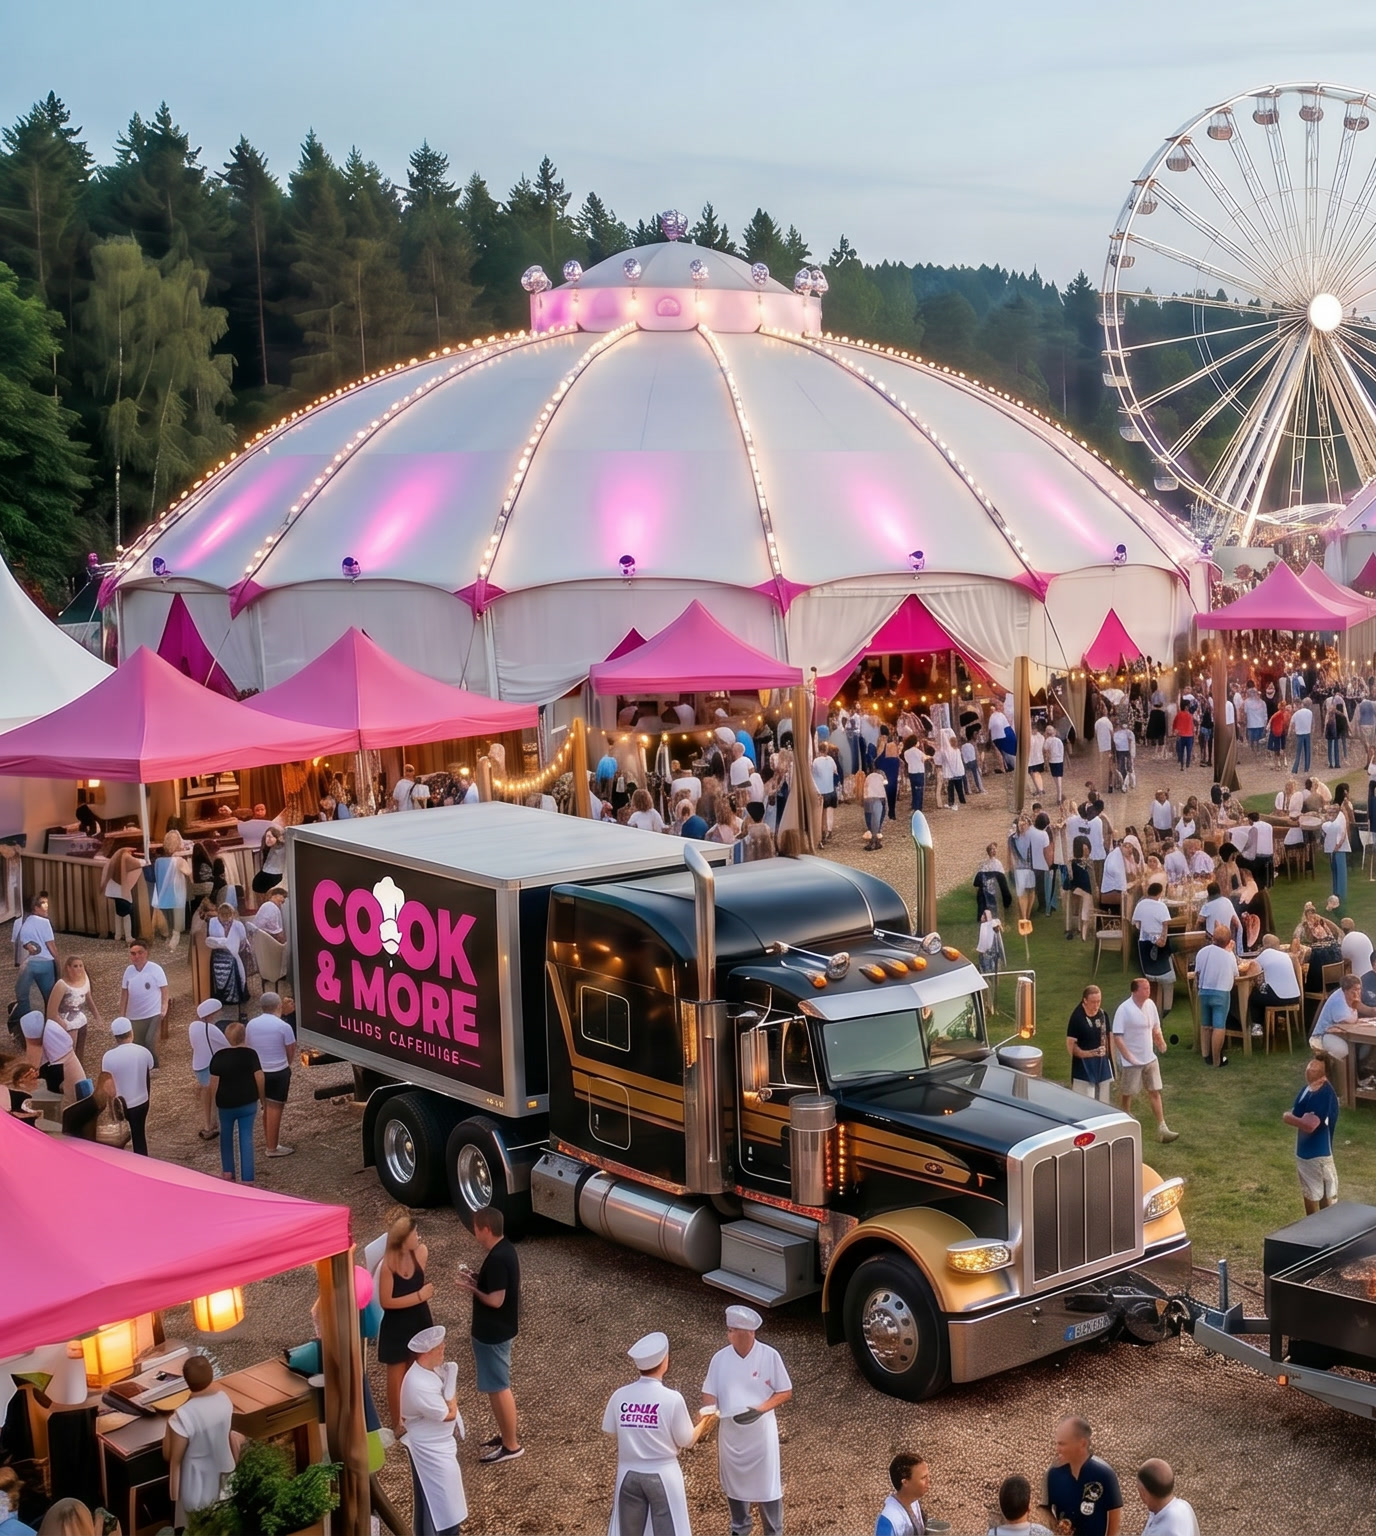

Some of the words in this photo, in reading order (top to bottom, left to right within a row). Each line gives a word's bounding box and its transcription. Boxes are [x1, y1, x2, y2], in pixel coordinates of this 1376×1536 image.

[312, 879, 478, 987] COOK
[315, 950, 342, 1004] &
[351, 959, 480, 1048] MORE
